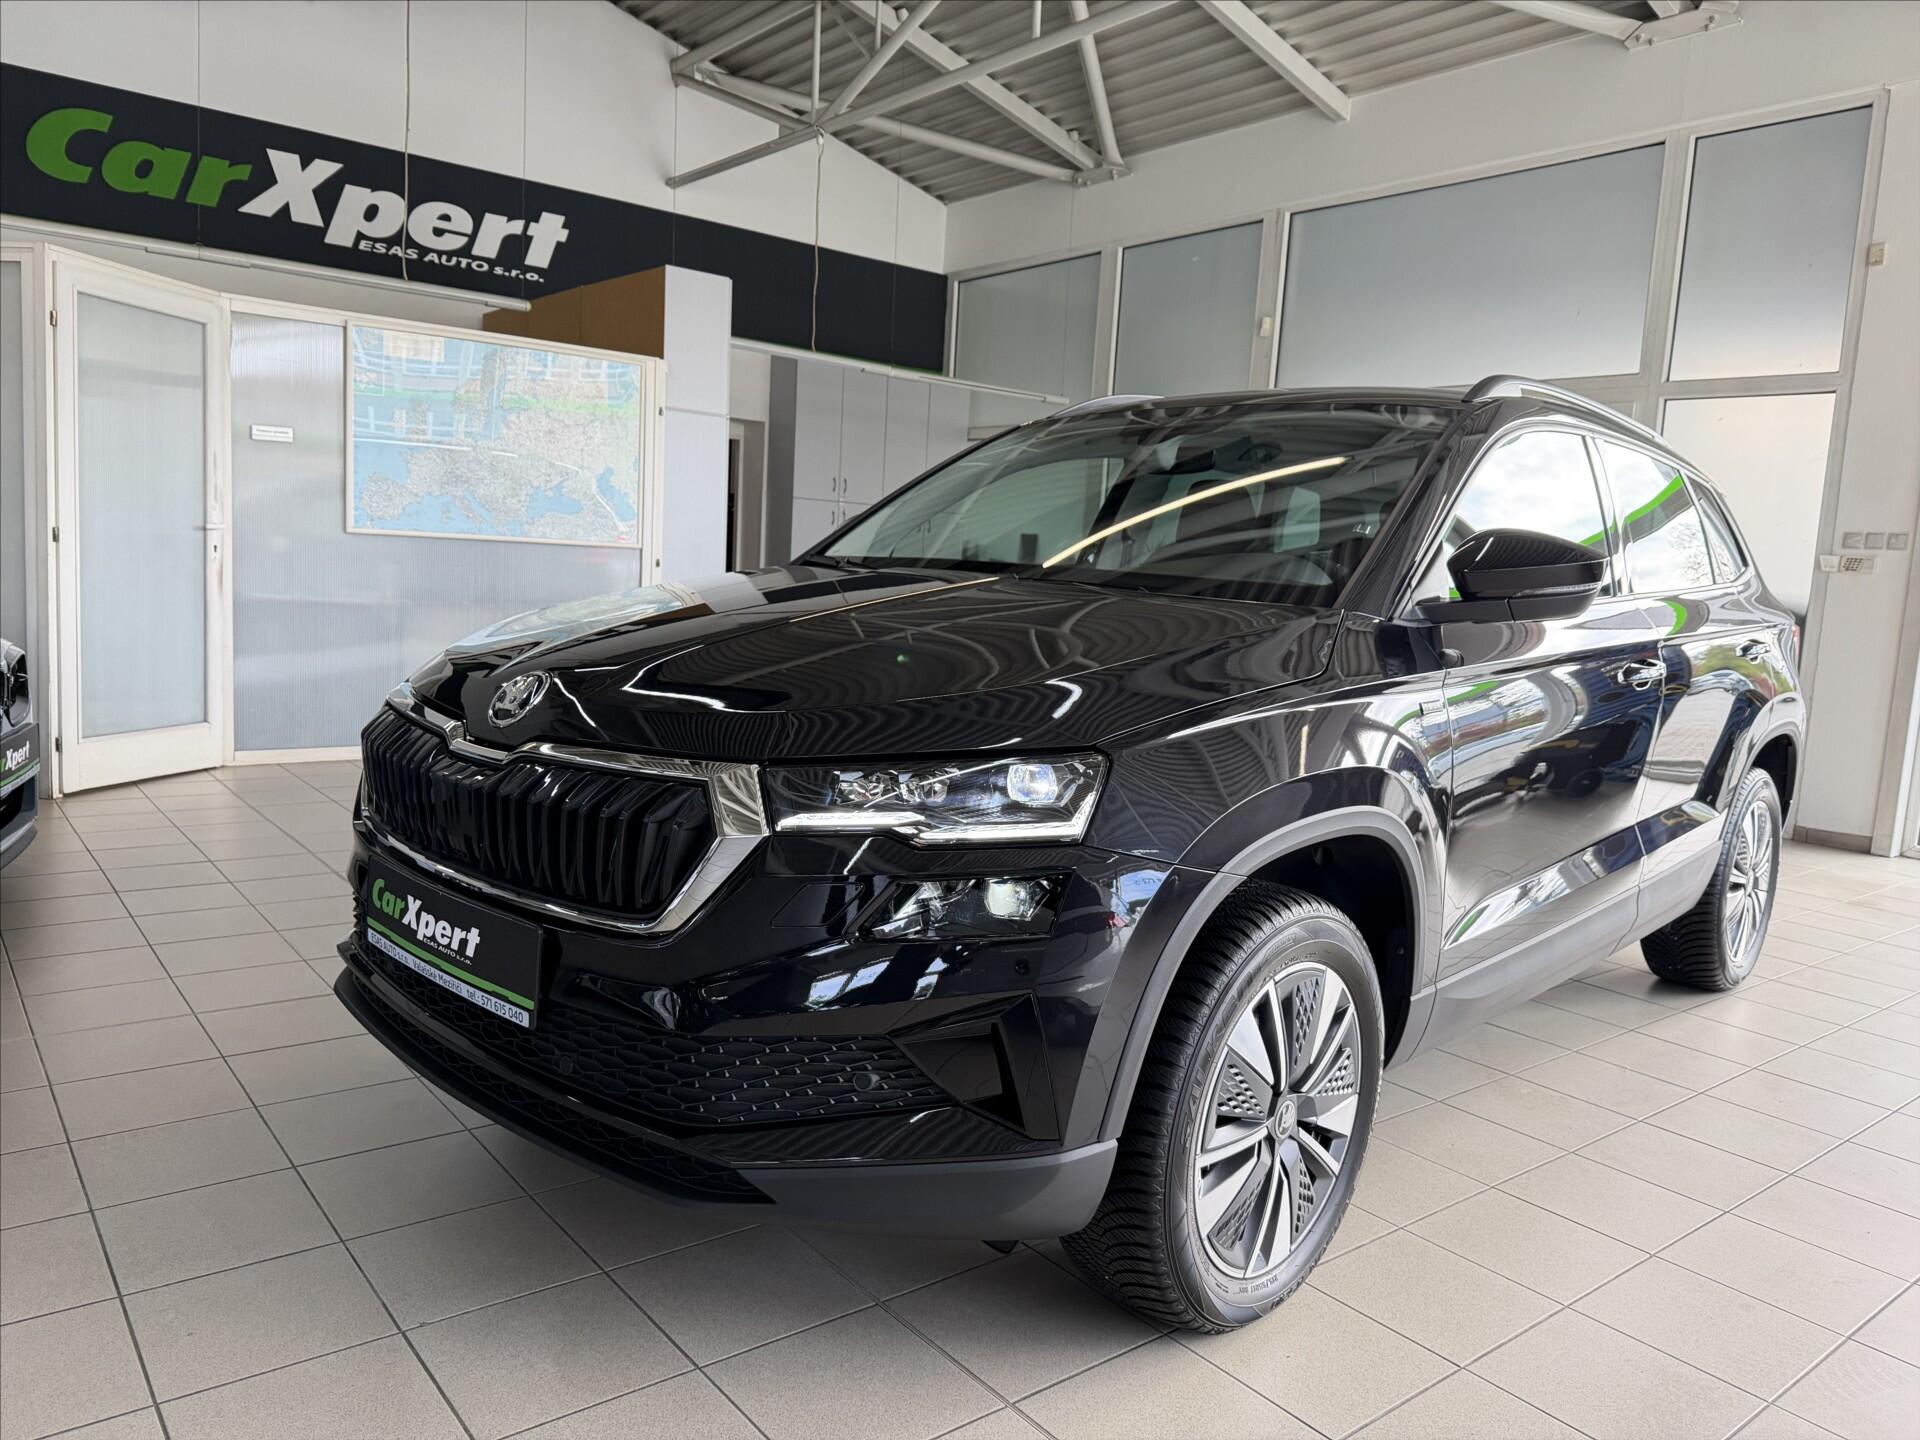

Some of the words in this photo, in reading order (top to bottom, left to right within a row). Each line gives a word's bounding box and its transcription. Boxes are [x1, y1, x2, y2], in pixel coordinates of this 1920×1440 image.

[25, 107, 569, 270] CarXpert
[358, 239, 419, 259] ESAS
[423, 252, 489, 272] AUTO
[493, 266, 545, 283] s.r.o.
[372, 879, 480, 958] CarXpert
[423, 938, 438, 949] ESAS
[438, 946, 456, 958] AUTO
[456, 955, 472, 966] s.r.o.
[371, 932, 383, 948] ESAS
[383, 940, 397, 957] AUTO
[481, 995, 493, 1010] 571
[494, 1001, 507, 1016] 615
[508, 1007, 524, 1023] 040
